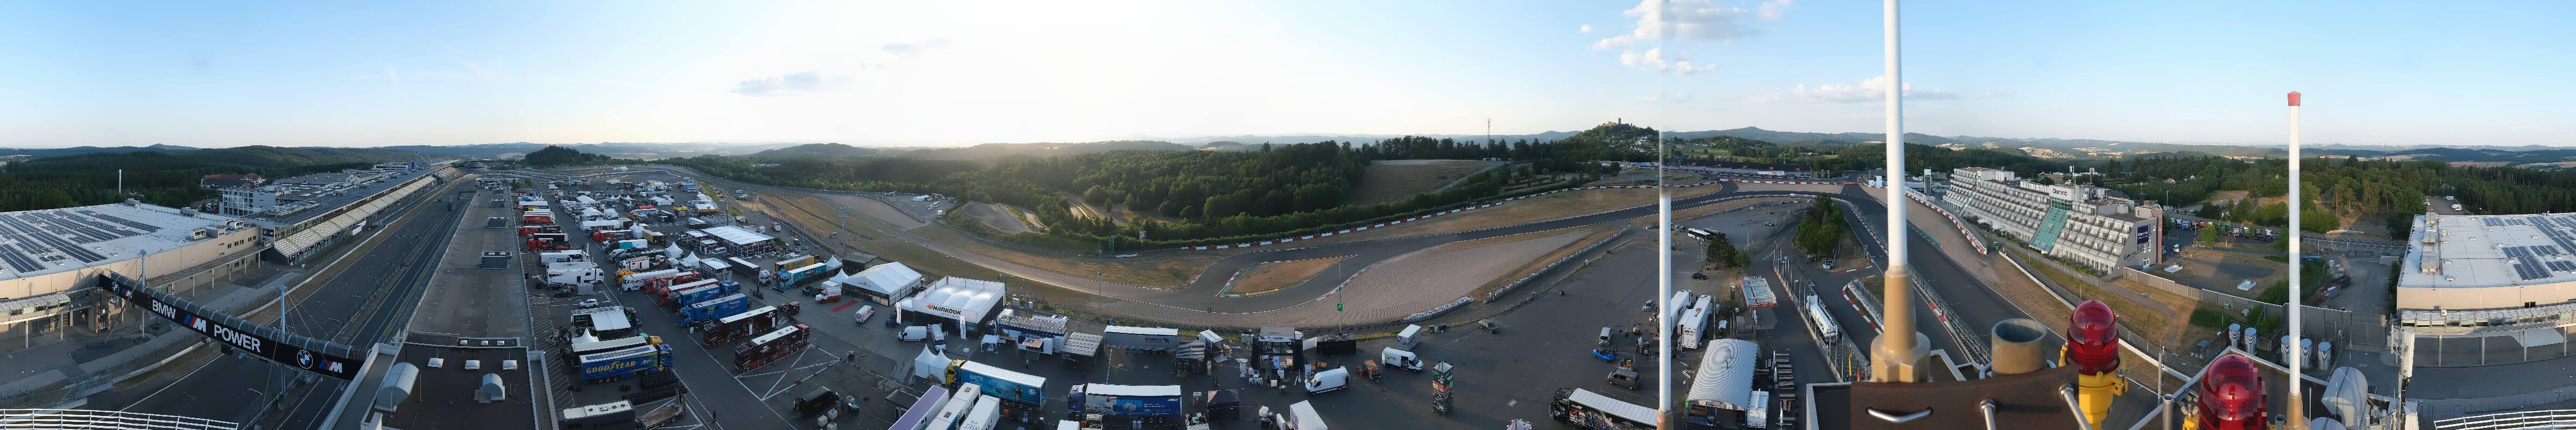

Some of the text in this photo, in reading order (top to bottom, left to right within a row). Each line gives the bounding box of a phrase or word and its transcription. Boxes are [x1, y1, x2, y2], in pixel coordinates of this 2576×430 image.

[2052, 188, 2067, 196] Dorint
[152, 299, 260, 353] BMW M POWER
[329, 361, 343, 373] M
